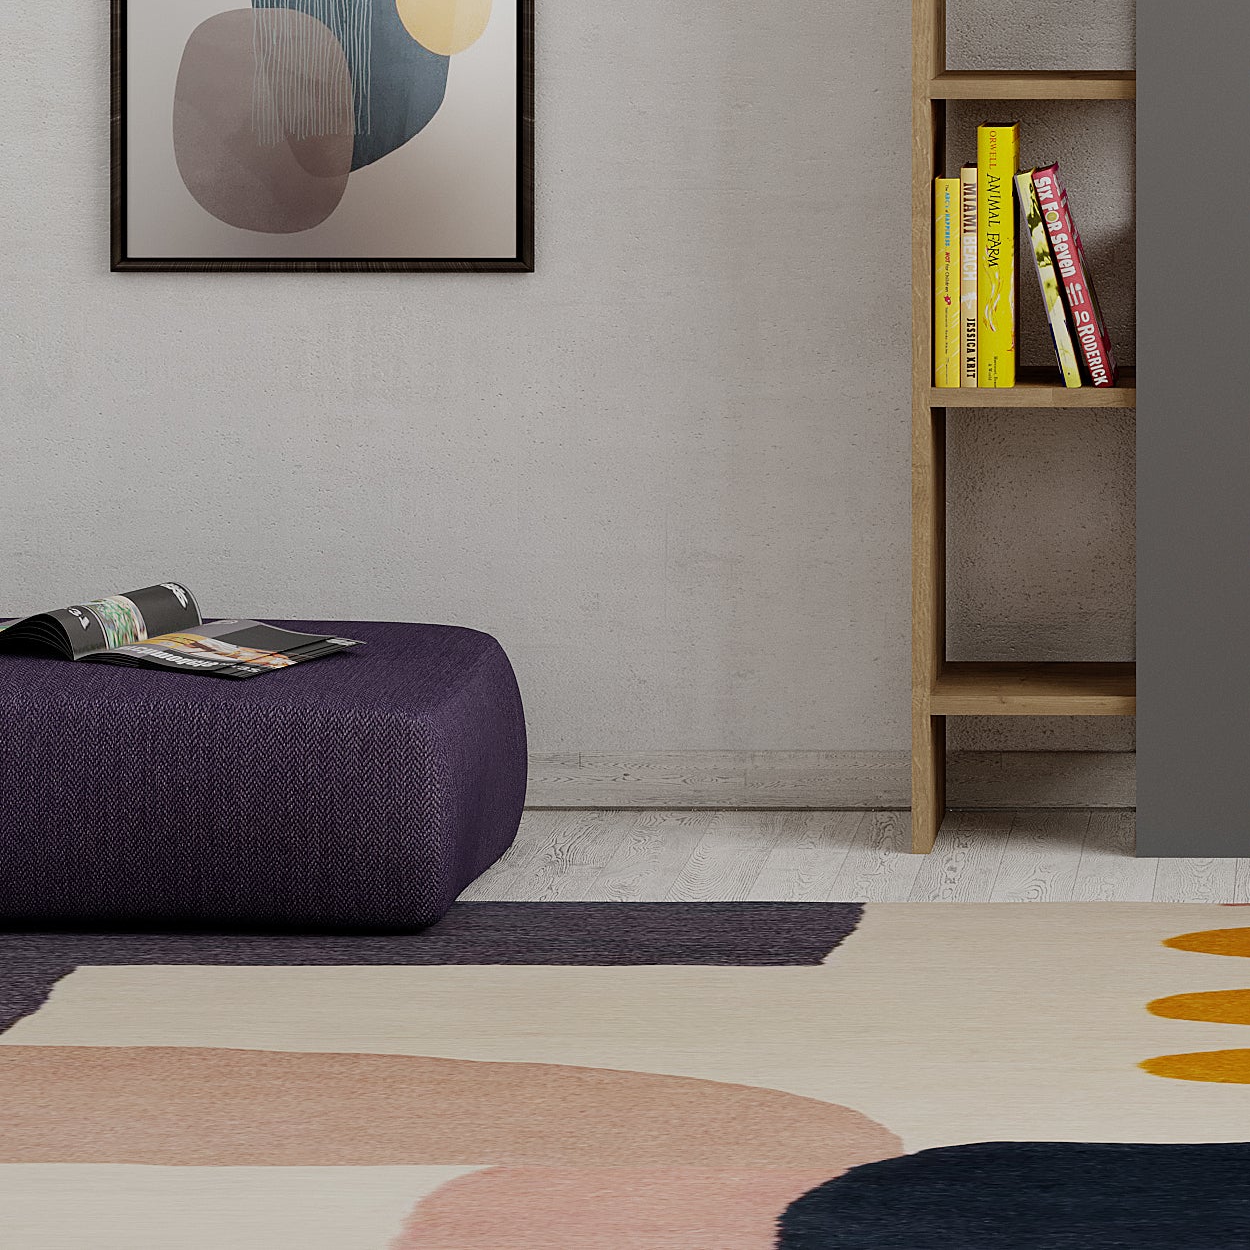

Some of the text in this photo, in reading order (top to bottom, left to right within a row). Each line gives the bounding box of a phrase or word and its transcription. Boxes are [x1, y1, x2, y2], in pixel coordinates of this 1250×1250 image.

[989, 131, 997, 169] ORWELL
[963, 183, 977, 280] MIAMI BEACH
[987, 173, 1001, 267] ANIMAL FARM
[1033, 177, 1076, 277] SIX FOR Seven
[967, 318, 975, 353] JESSICA
[1077, 324, 1108, 386] RODERICK
